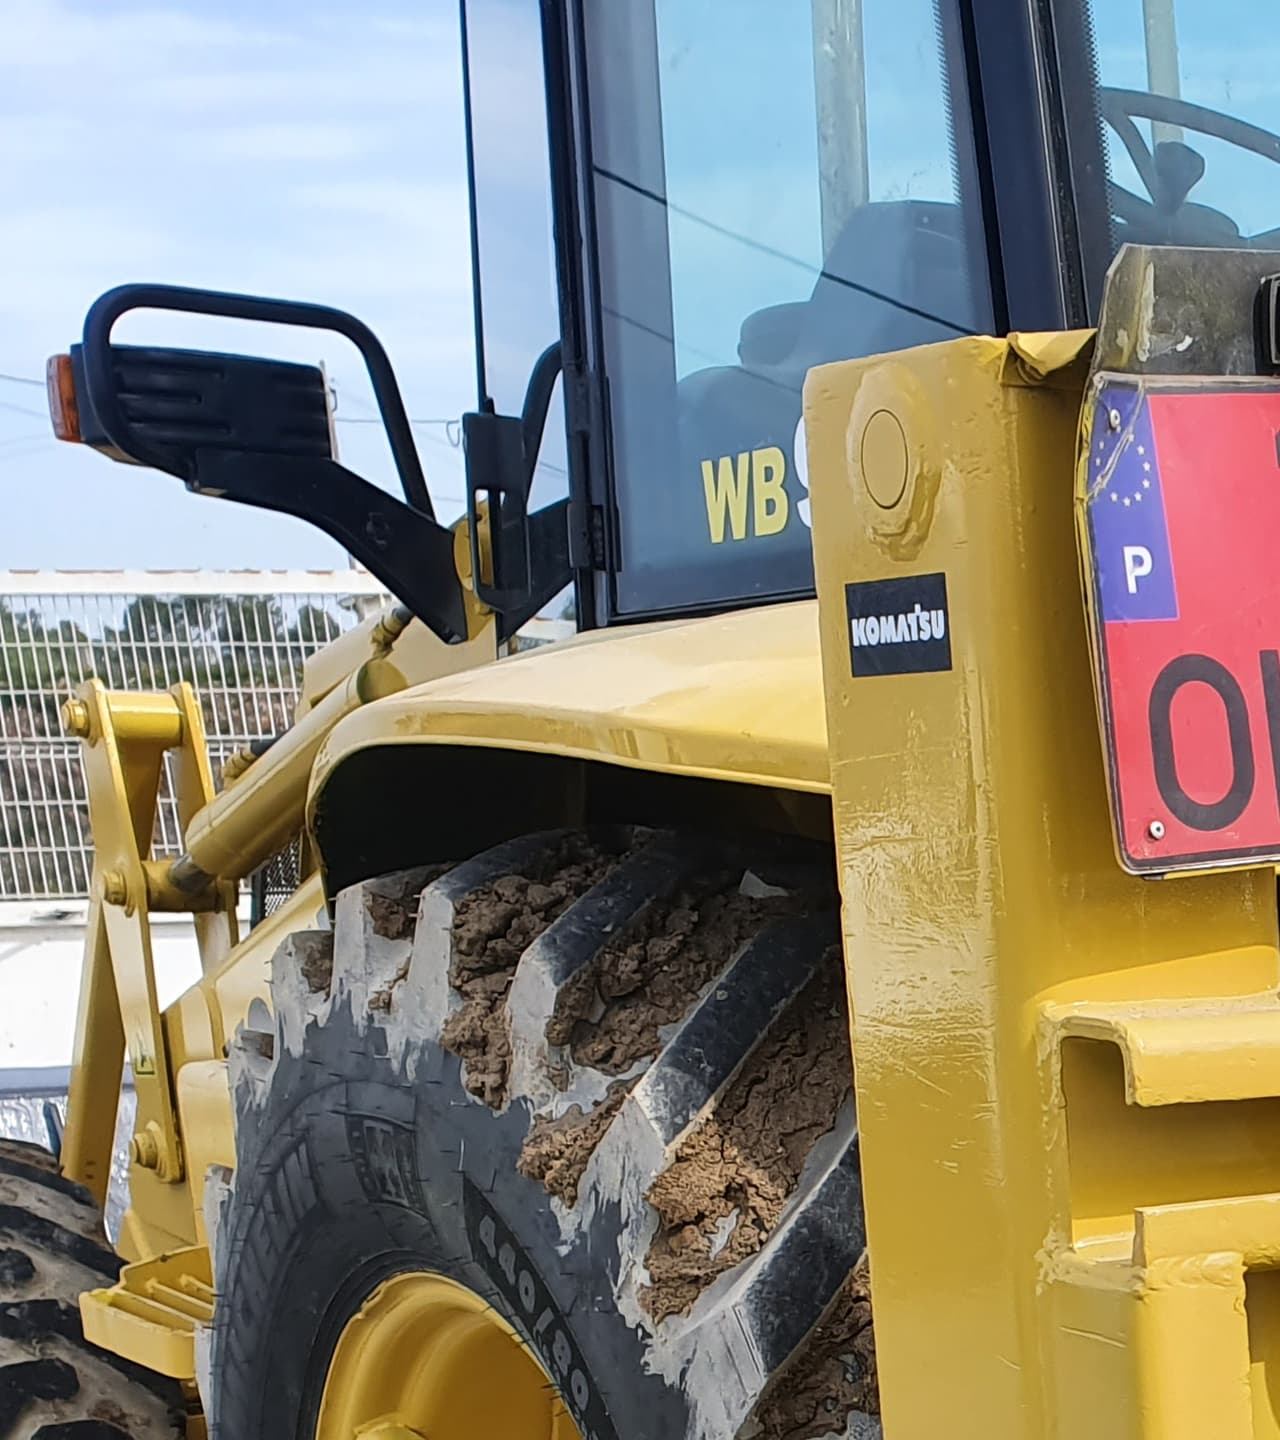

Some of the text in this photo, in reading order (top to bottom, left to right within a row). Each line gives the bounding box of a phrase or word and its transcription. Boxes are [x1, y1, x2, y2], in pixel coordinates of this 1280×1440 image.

[701, 446, 788, 543] WB
[1123, 546, 1153, 594] P
[852, 603, 945, 647] KOMATSU
